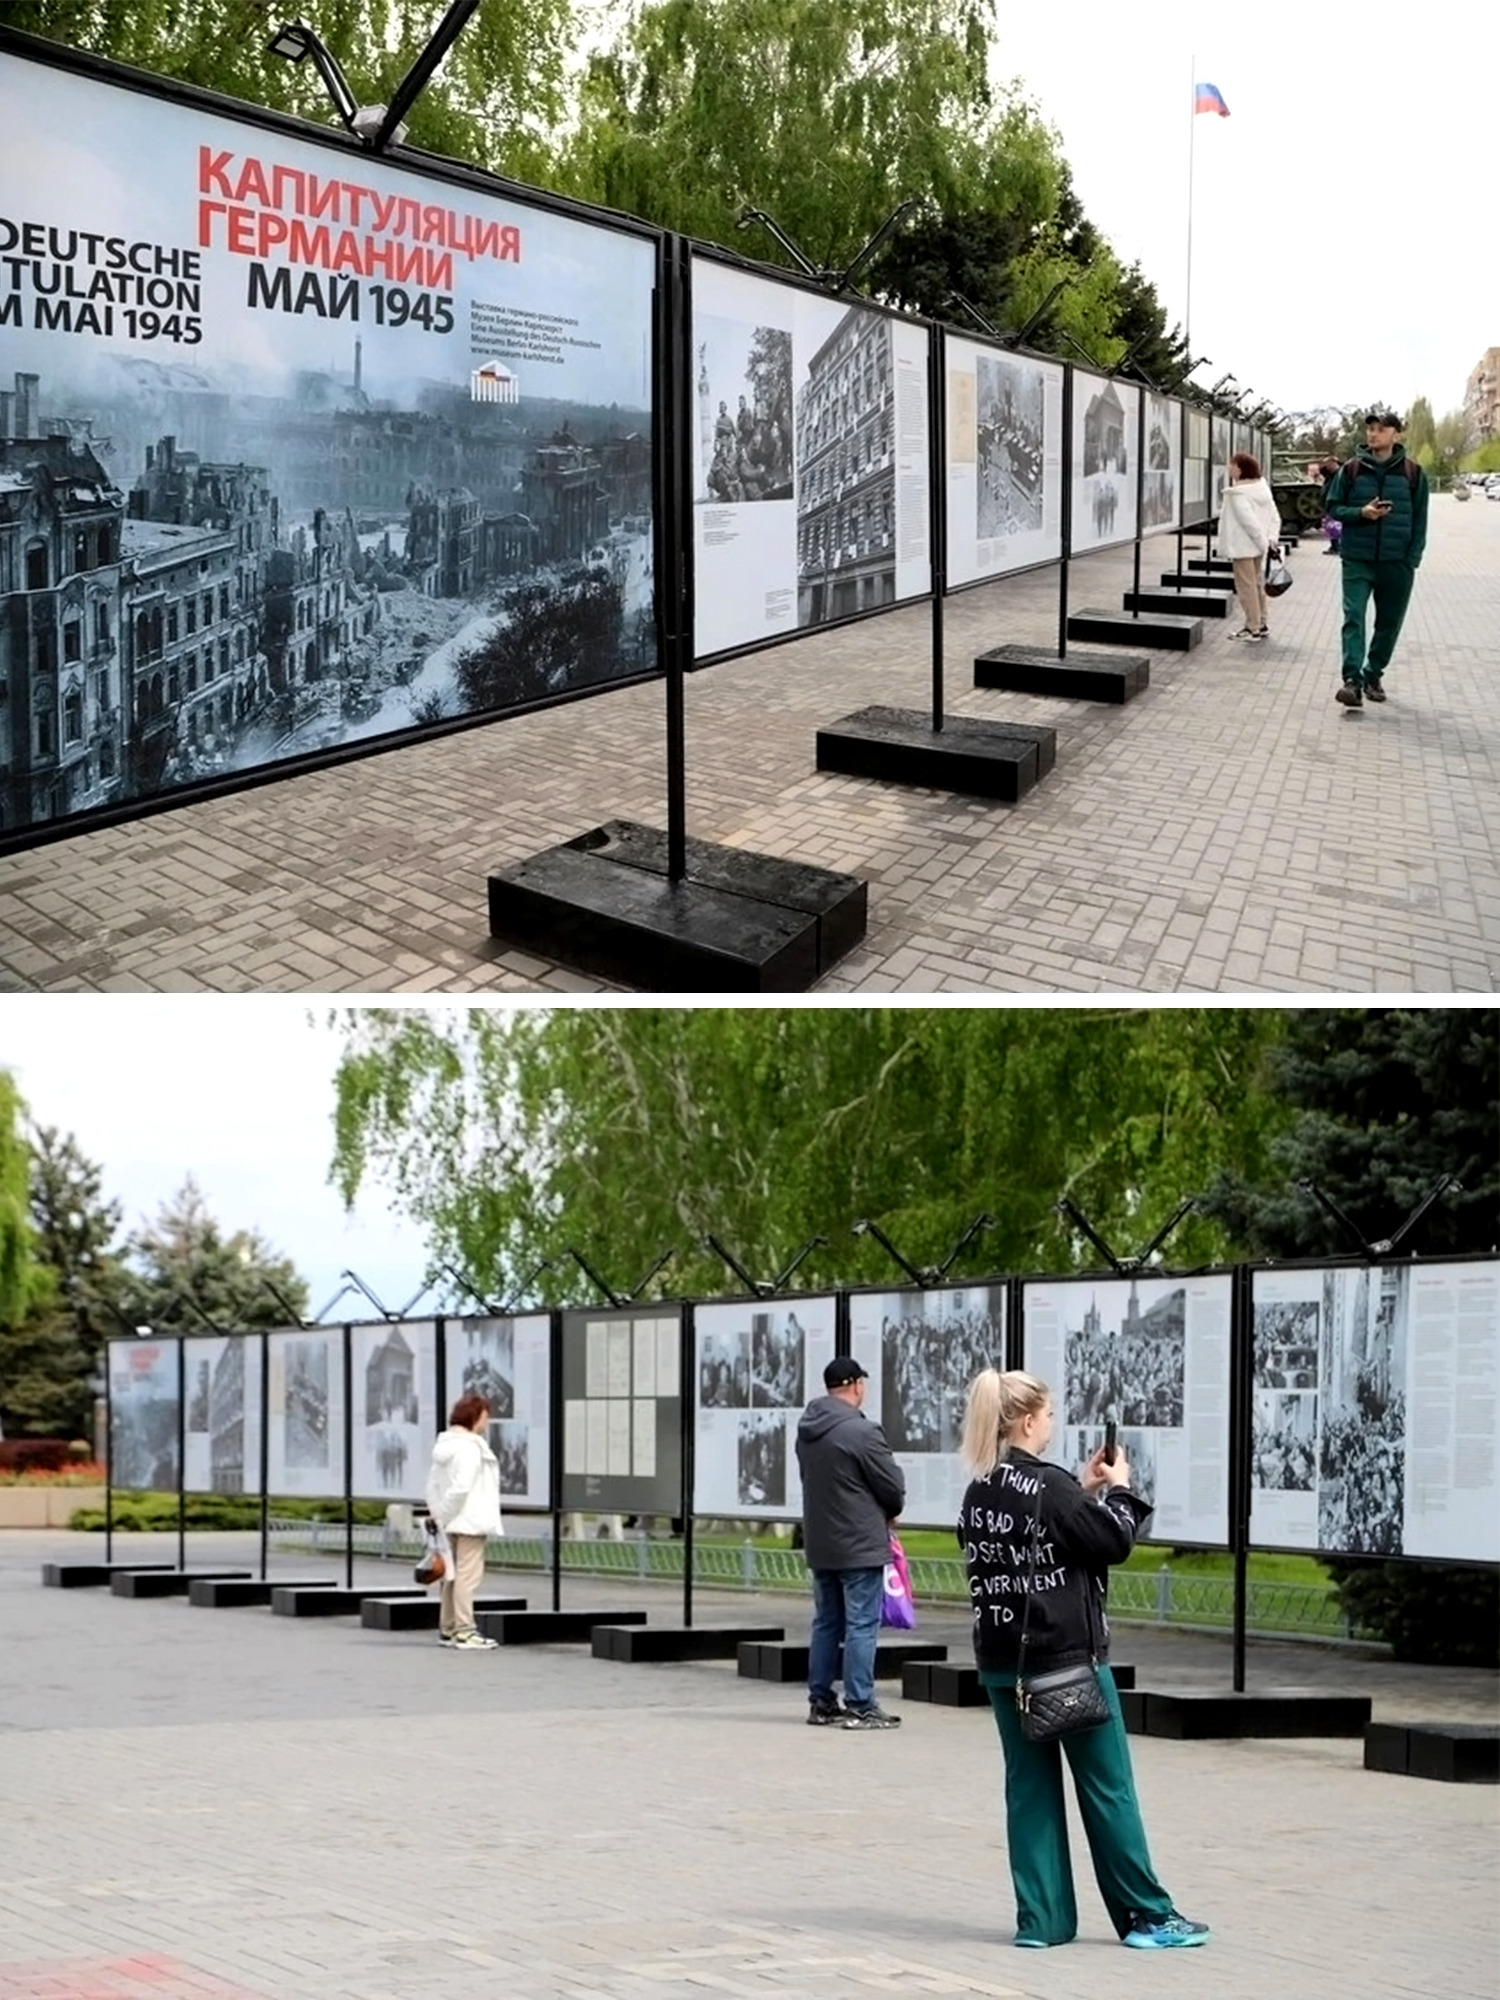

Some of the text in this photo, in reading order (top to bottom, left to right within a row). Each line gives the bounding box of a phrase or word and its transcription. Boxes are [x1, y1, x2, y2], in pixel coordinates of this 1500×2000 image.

[198, 145, 521, 264] КАПИТУЛЯЦИЯ
[0, 217, 201, 281] DEUTSCHE
[198, 201, 453, 291] ГЕРМАНИИ
[2, 256, 201, 313] TULATION
[247, 261, 455, 335] МАЙ 1945
[34, 297, 113, 337] MAI
[122, 309, 203, 345] 1945
[970, 1506, 983, 1529] IS
[986, 1509, 1014, 1534] BAD
[989, 1605, 1015, 1627] TO
